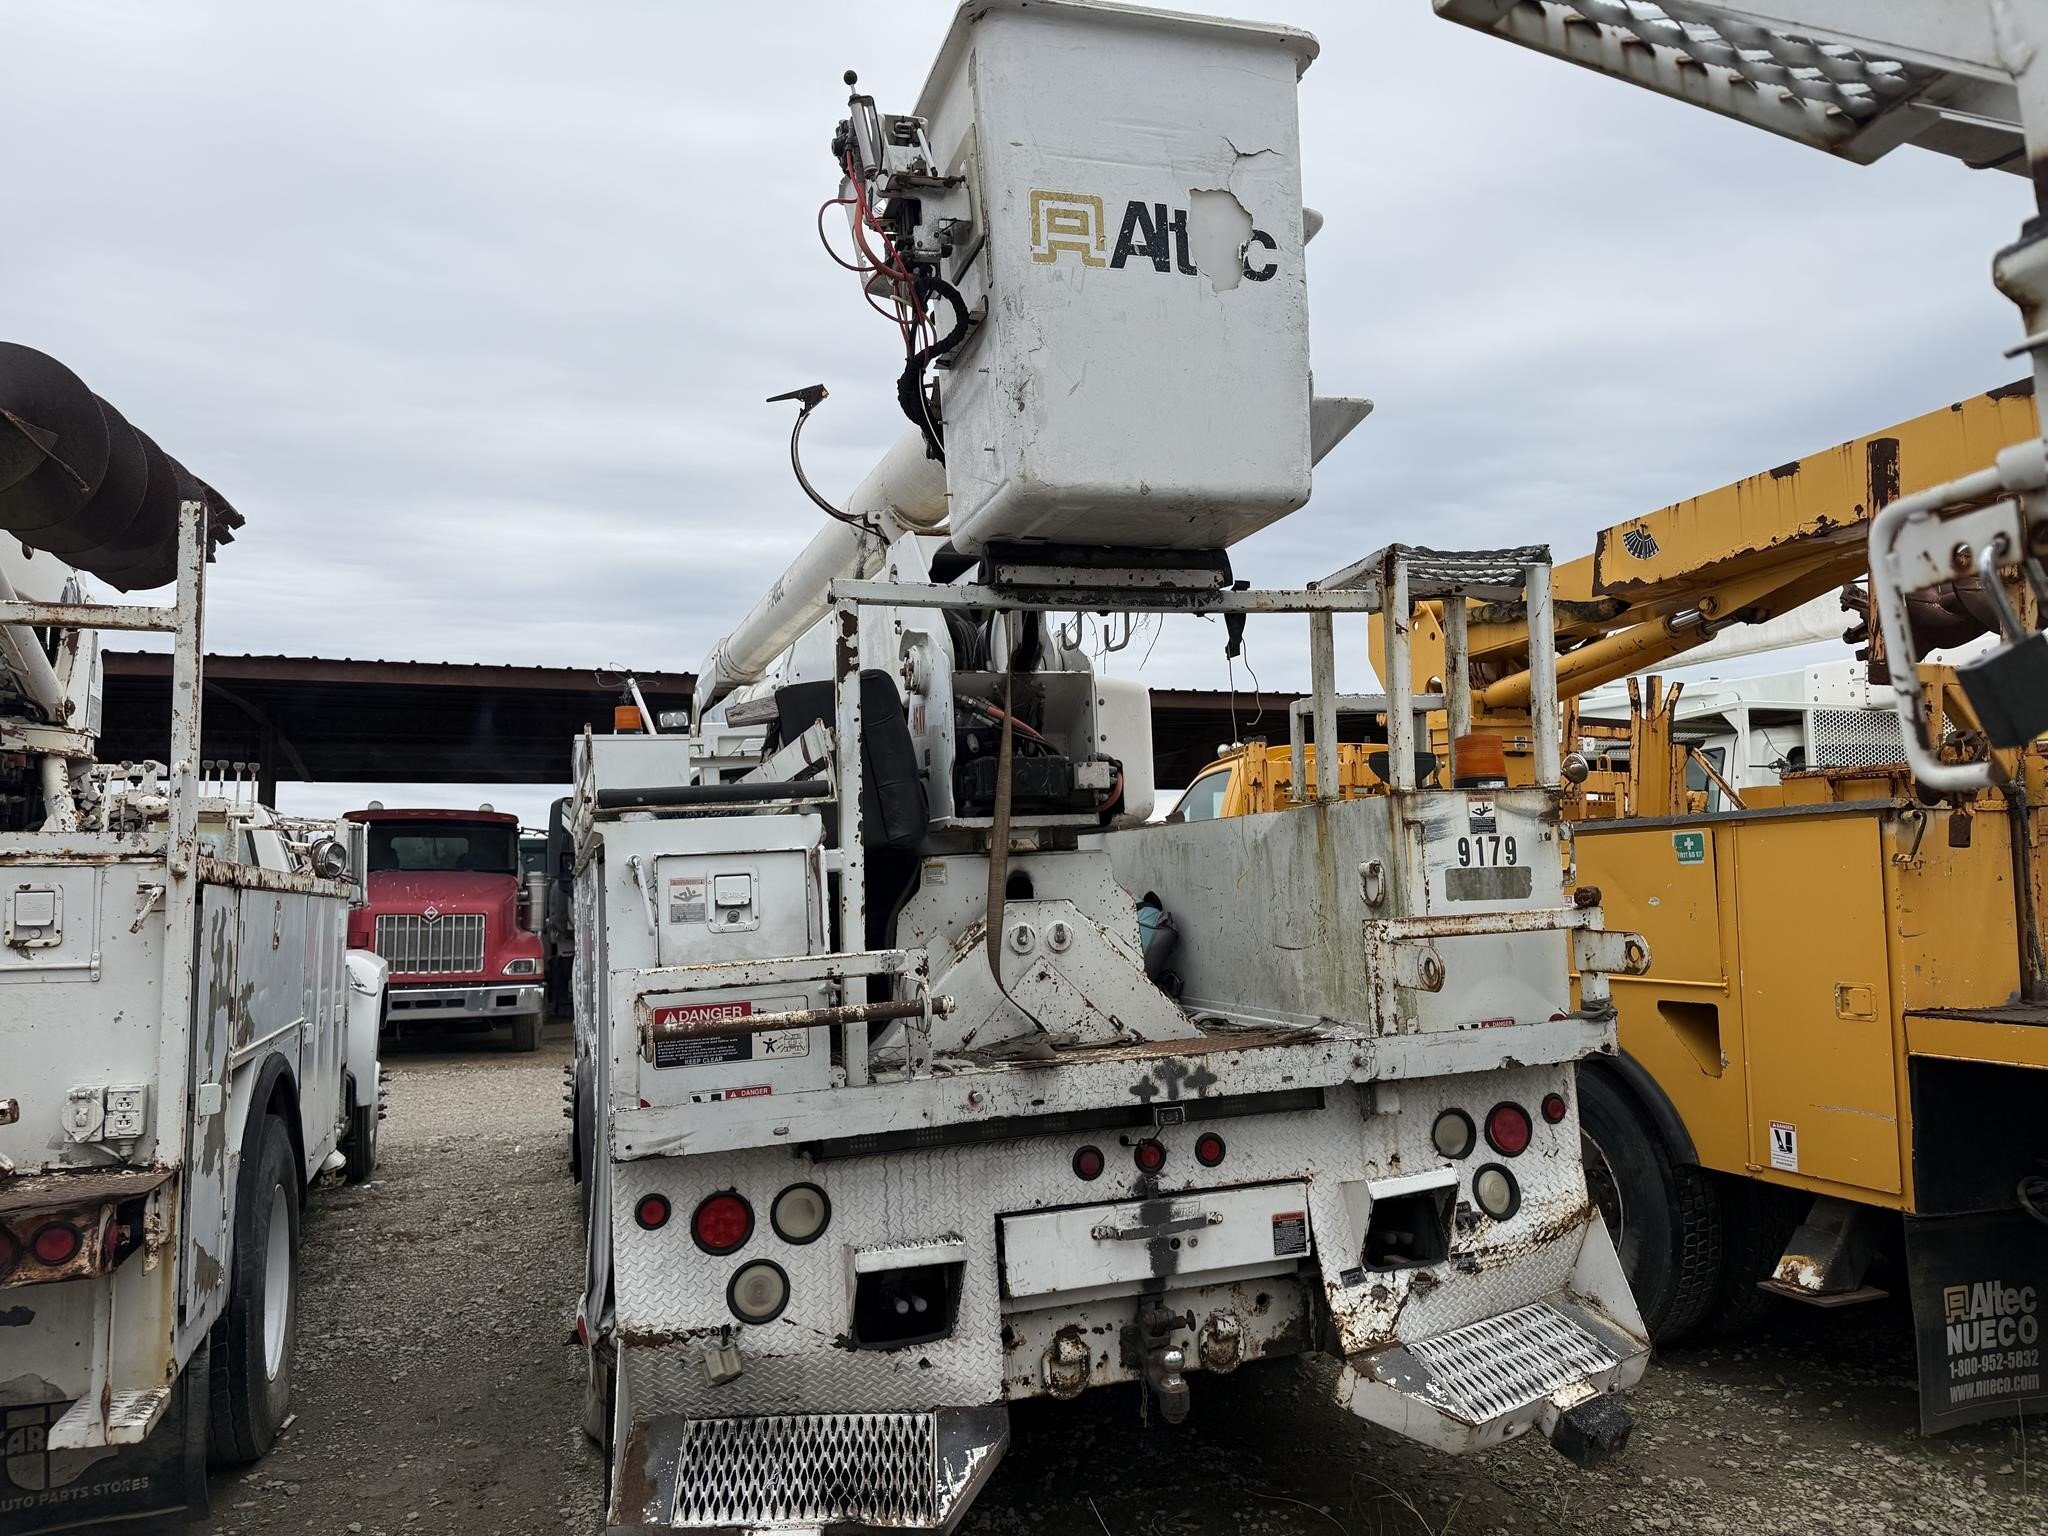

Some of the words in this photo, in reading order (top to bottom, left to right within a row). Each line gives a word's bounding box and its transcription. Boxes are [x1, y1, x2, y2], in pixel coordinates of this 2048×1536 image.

[1109, 200, 1279, 282] Altc
[1457, 836, 1517, 867] 9179
[678, 1006, 743, 1022] DANGER
[1492, 1019, 1513, 1027] DANGER
[702, 1056, 723, 1064] CLEAR
[741, 1087, 768, 1096] DANGER
[1969, 1280, 2038, 1320] Altec
[1946, 1315, 2039, 1356] NUECO
[1949, 1349, 2039, 1379] 1-800-952-5832
[1950, 1374, 2039, 1403] www.nueco.com
[38, 1486, 89, 1506] PARTS
[93, 1477, 149, 1496] STORES
